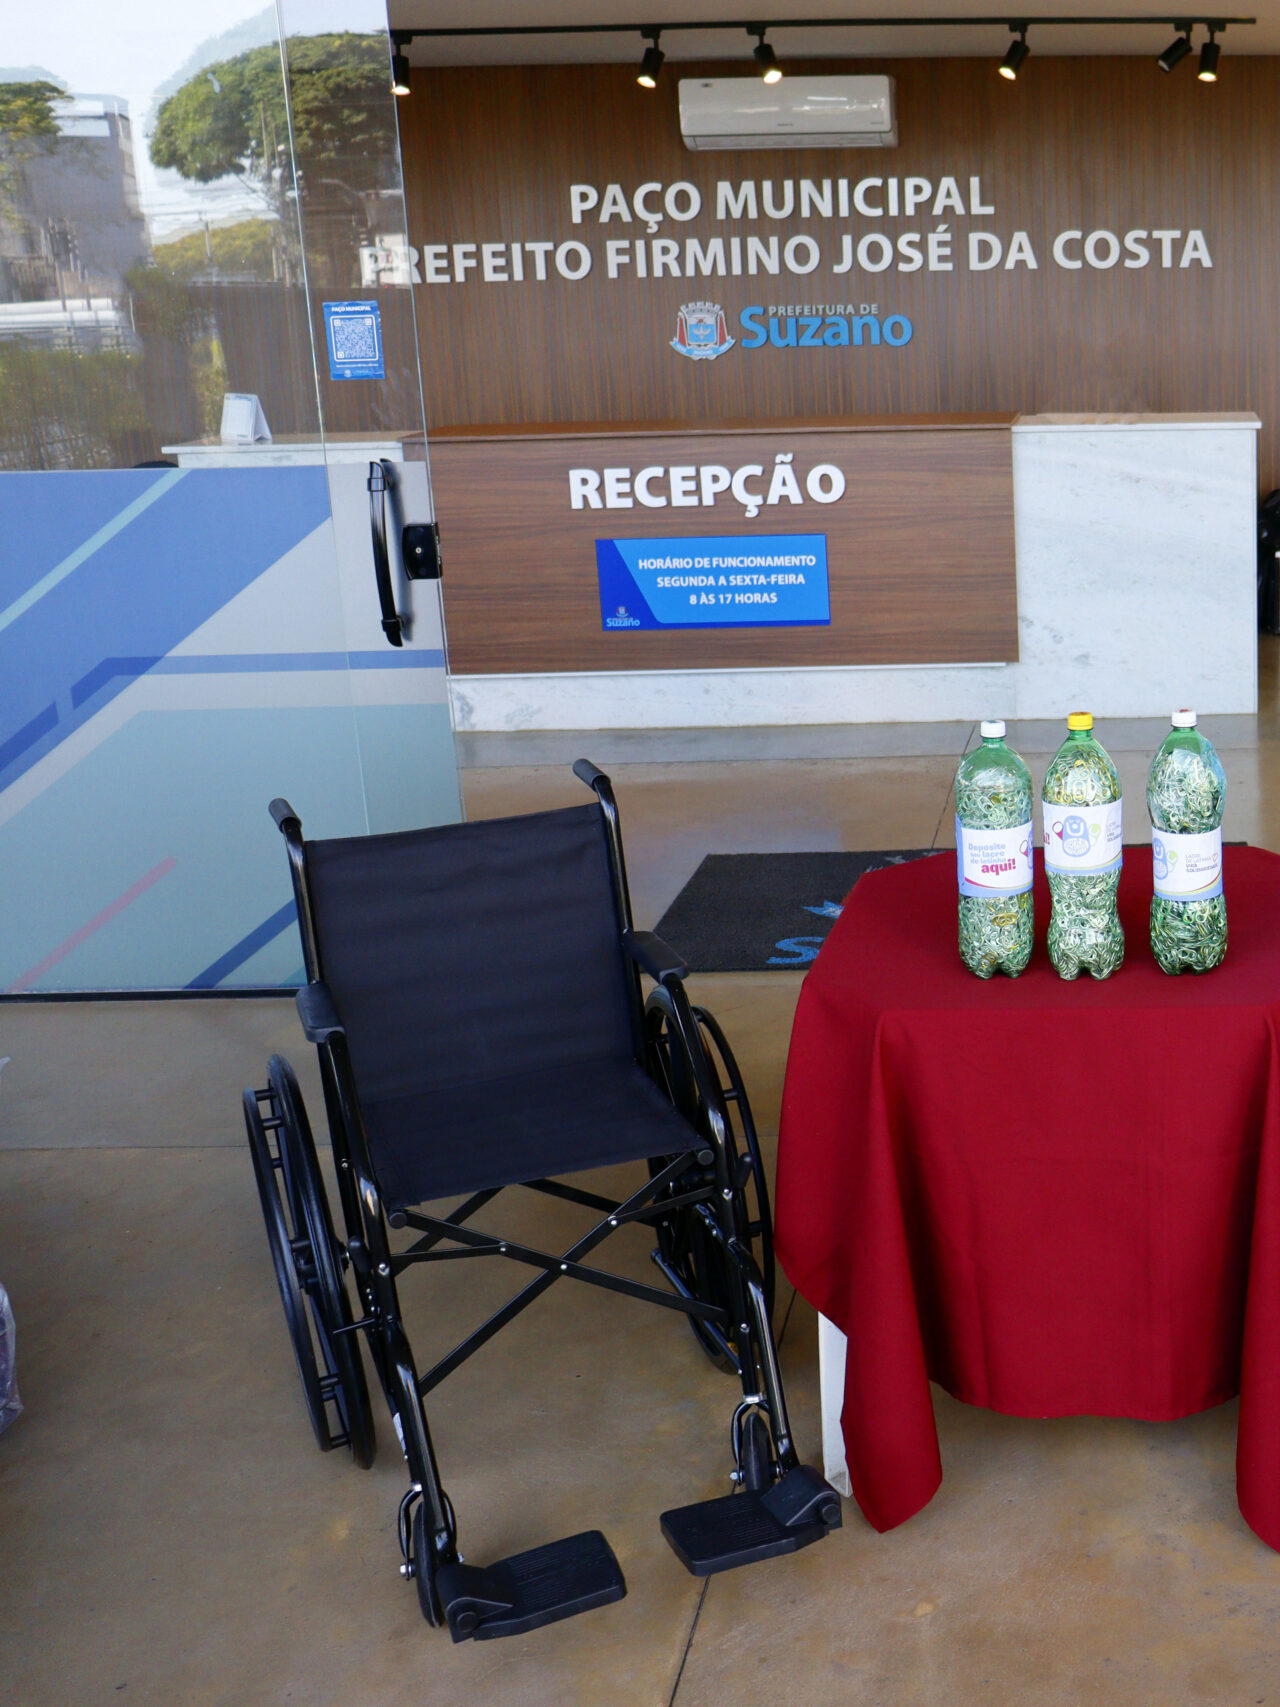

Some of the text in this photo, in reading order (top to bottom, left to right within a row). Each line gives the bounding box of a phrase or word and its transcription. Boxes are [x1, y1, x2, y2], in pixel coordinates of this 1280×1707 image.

[570, 176, 995, 233] PAÇO MUNICIPAL
[359, 223, 1214, 286] PREFEITO FIRMINO JOSÉ DA COSTA
[768, 303, 879, 316] PREFEITURA DE
[739, 305, 913, 348] Suzano
[568, 453, 846, 518] RECEPÇÃO
[638, 555, 816, 570] HORÁRIO DE FUNCIONAMENTO
[656, 573, 806, 588] SEGUNDA A SEXTA-FEIRA
[689, 591, 778, 605] 8 ÀS 17 HORAS
[981, 858, 1016, 876] aqui!
